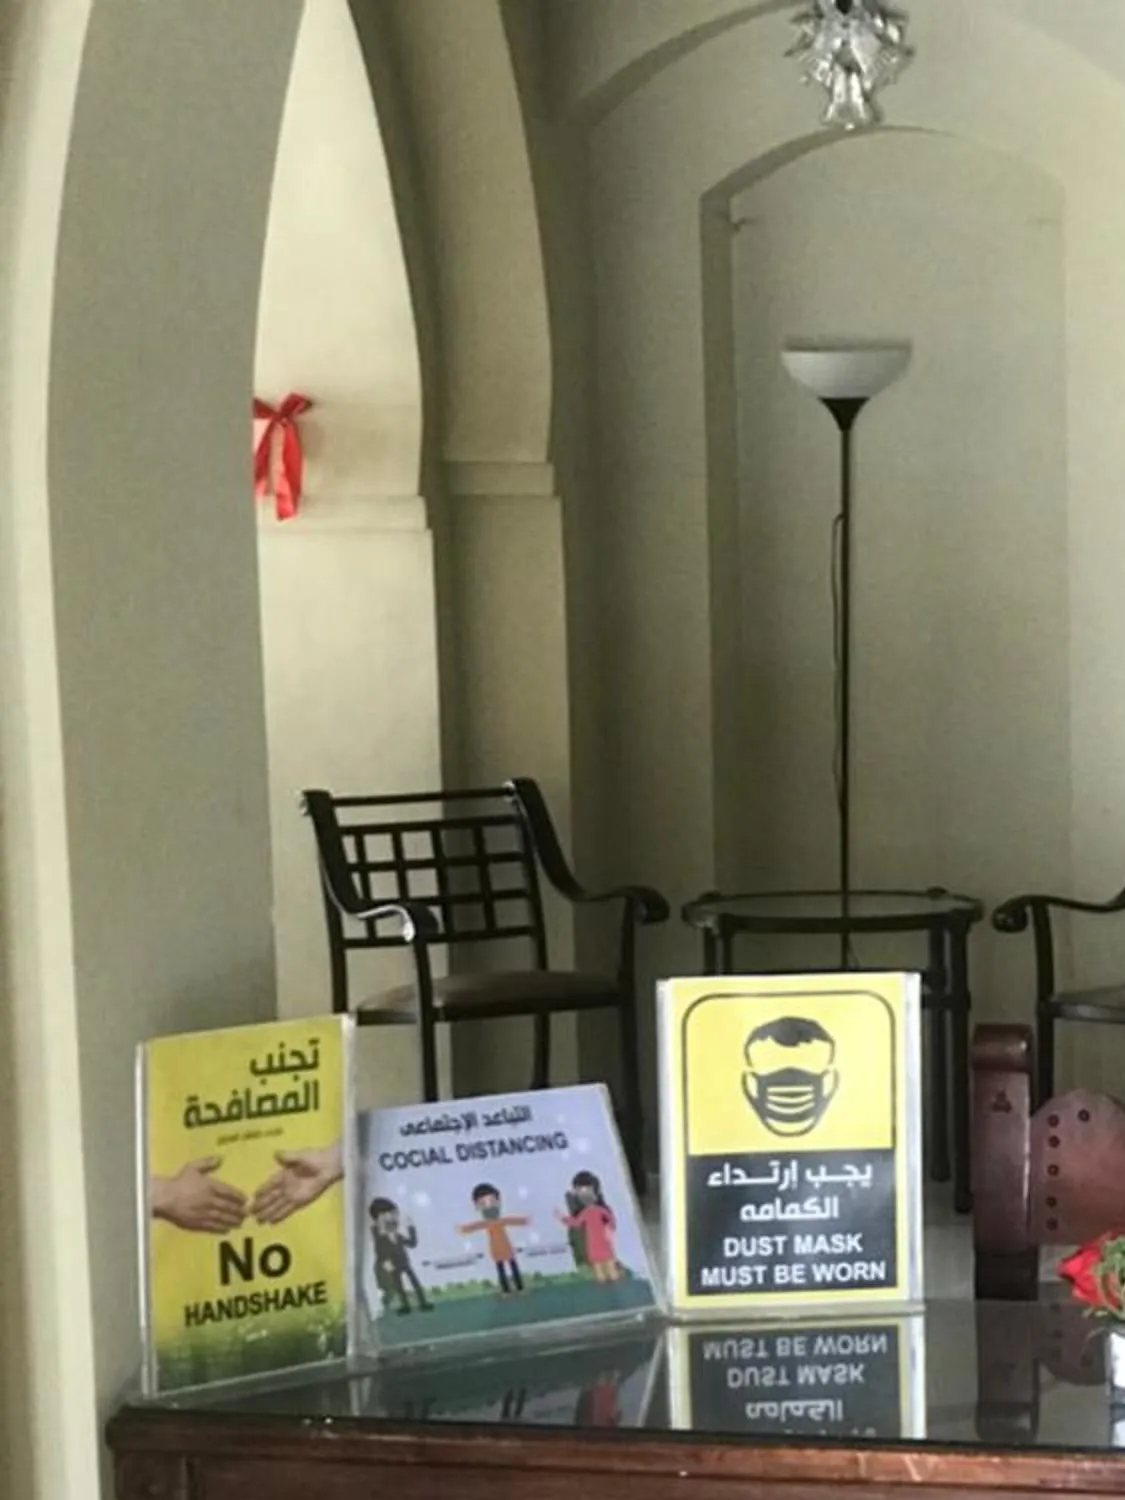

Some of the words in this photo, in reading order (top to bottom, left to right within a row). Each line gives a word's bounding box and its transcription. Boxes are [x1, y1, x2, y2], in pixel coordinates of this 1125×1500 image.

[250, 1037, 320, 1086] تجنب
[184, 1078, 320, 1130] المصافحة
[455, 1131, 569, 1162] DISTANCING
[218, 1236, 292, 1286] No
[723, 1235, 788, 1258] DUST
[793, 1232, 864, 1255] MASK
[701, 1265, 768, 1287] MUST
[773, 1264, 807, 1284] BE
[811, 1261, 887, 1282] WORN
[184, 1280, 327, 1327] HANDSHAKE
